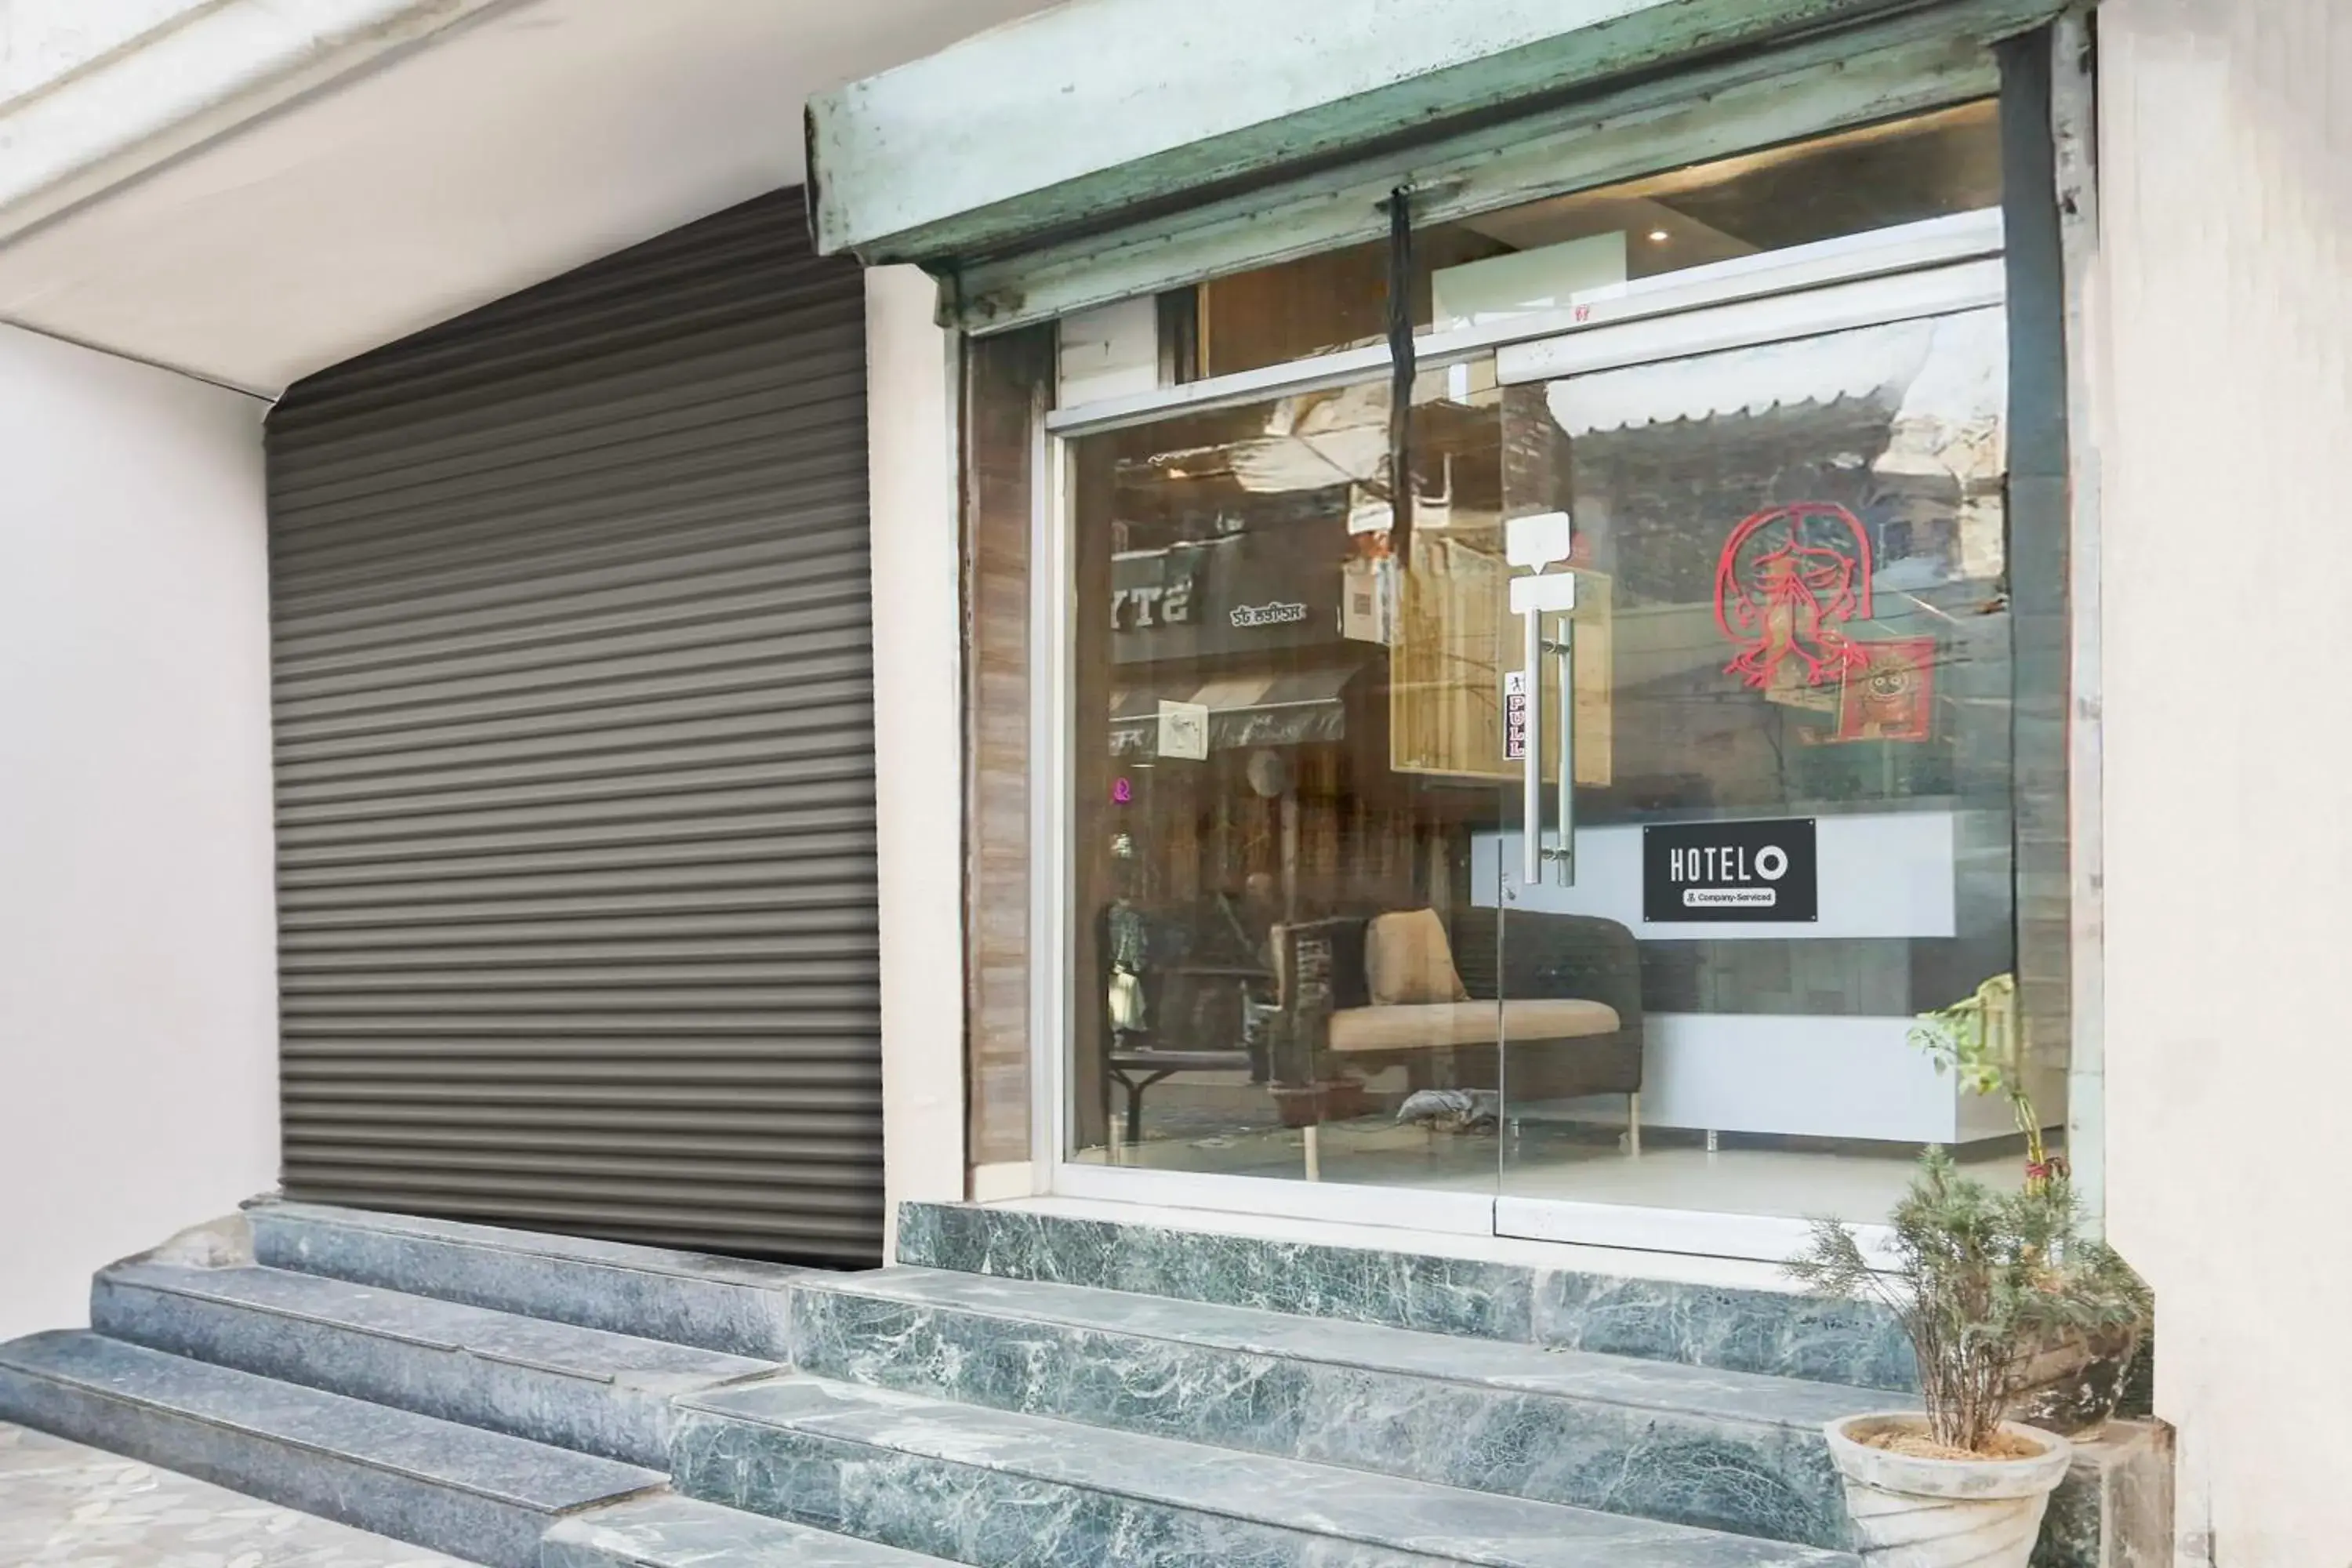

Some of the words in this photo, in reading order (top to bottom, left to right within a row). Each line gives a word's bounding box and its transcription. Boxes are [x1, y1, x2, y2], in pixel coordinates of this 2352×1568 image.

[1509, 695, 1525, 757] PULL
[1671, 847, 1751, 881] HOTEL
[1697, 891, 1772, 902] Company-Serviced
